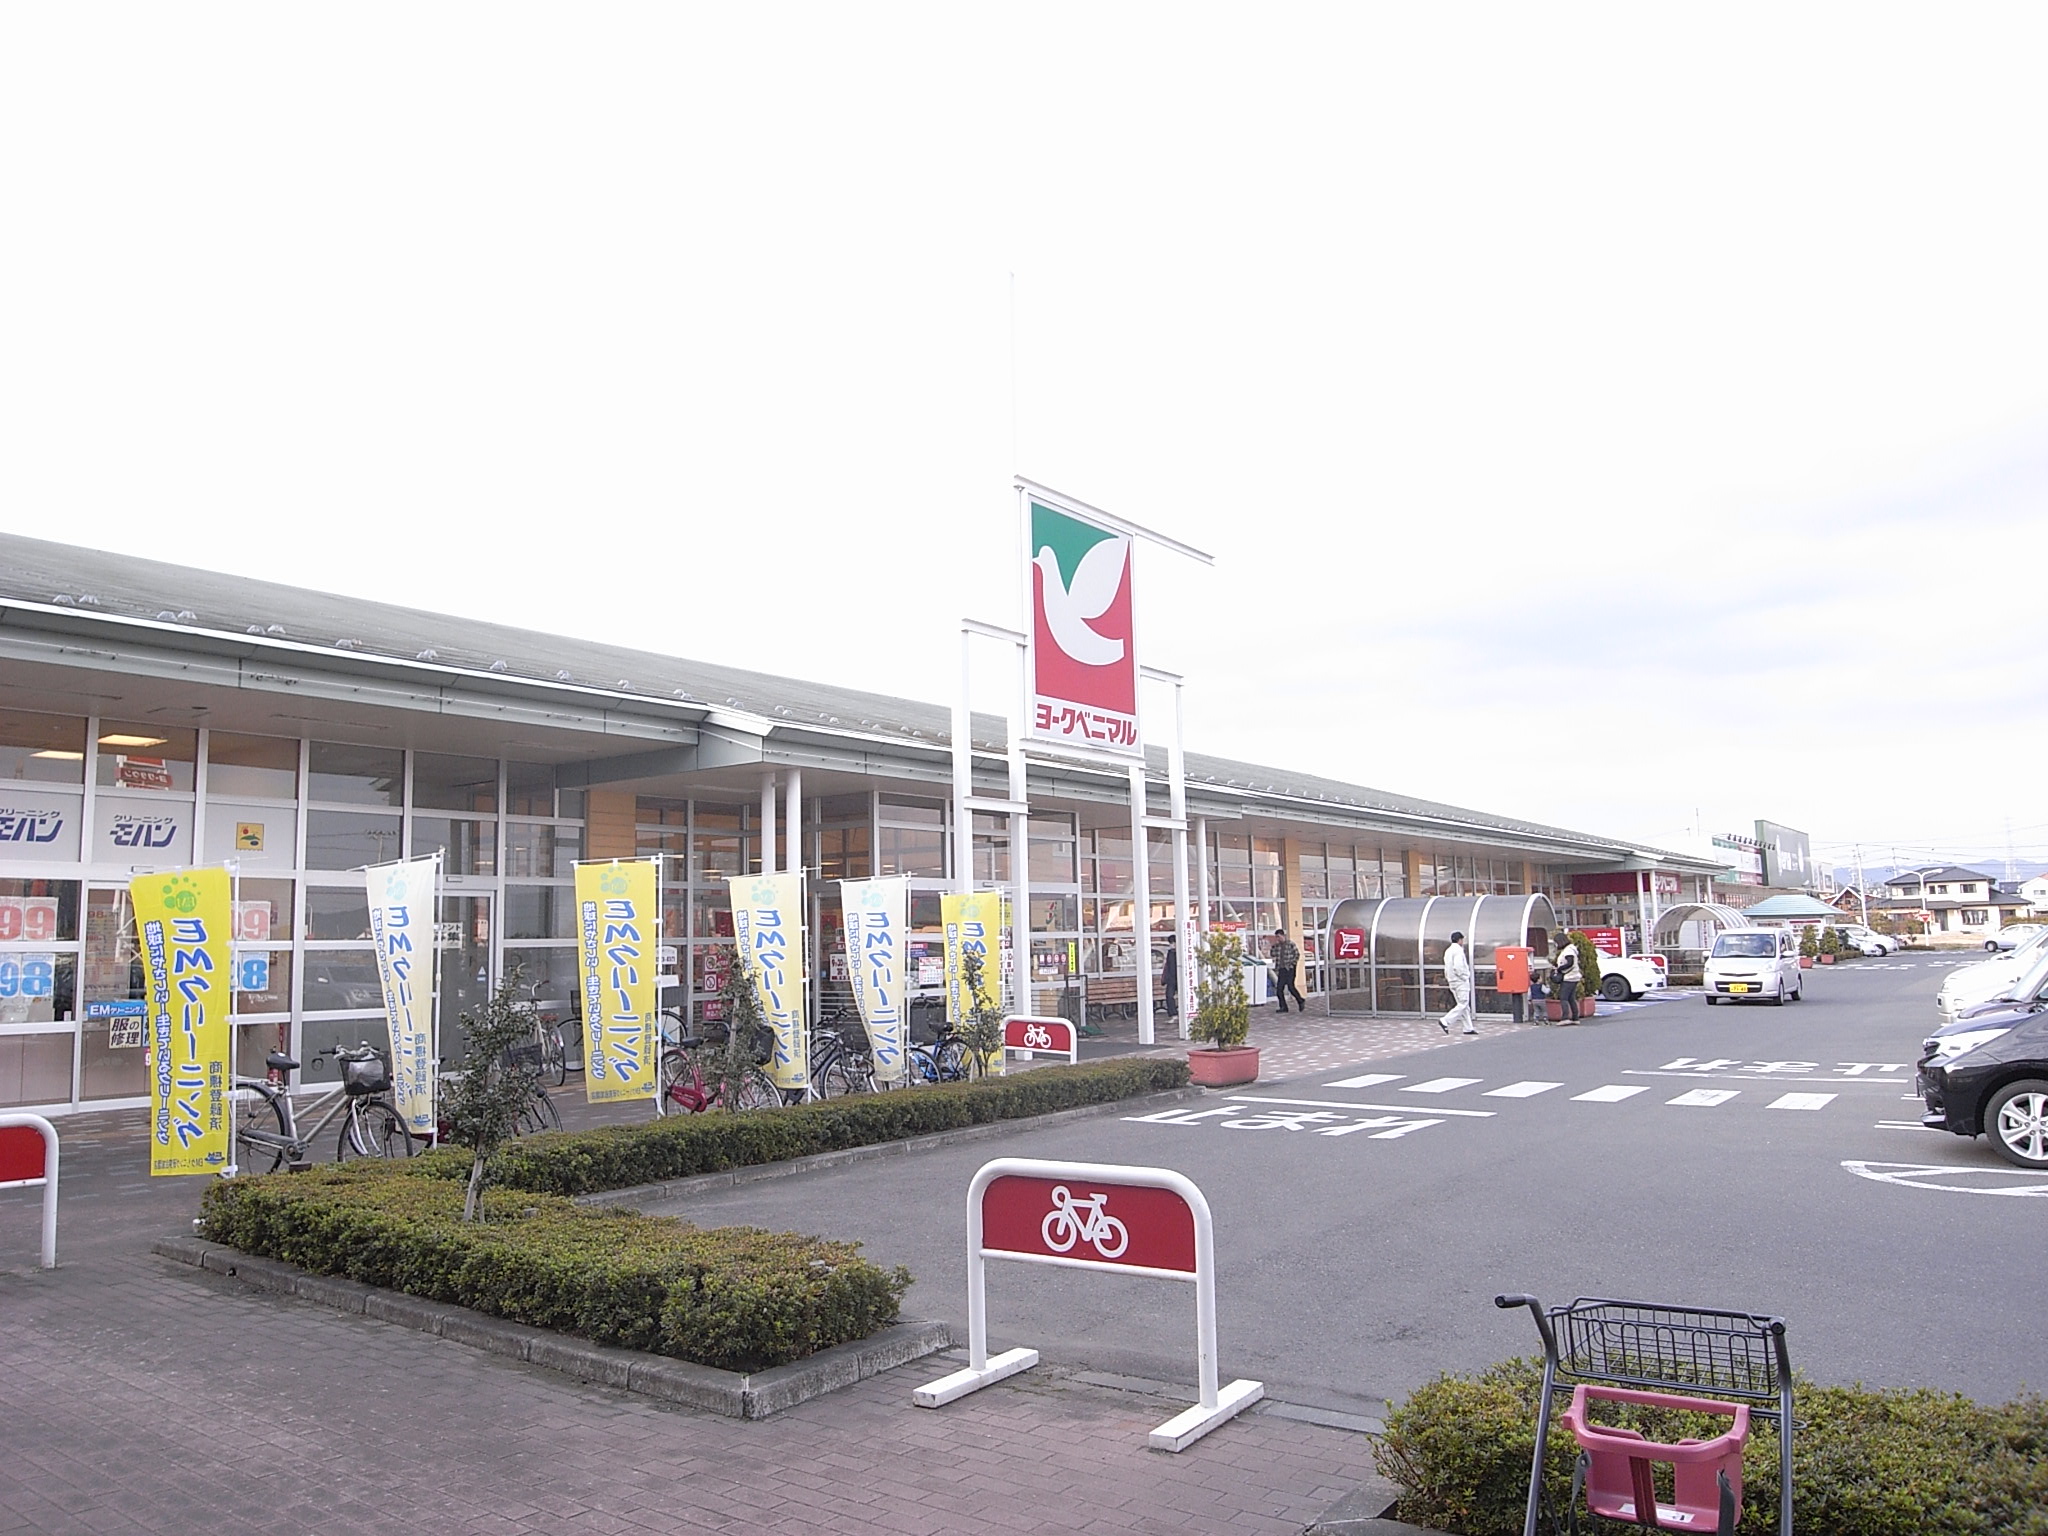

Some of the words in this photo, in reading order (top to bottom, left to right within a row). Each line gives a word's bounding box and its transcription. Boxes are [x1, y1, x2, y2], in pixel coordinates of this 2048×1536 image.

[1035, 703, 1137, 746] ヨークベニマル
[113, 814, 174, 825] クリーニング
[109, 824, 177, 847] モハン
[111, 1018, 139, 1032] 服の
[111, 1032, 139, 1046] 修理
